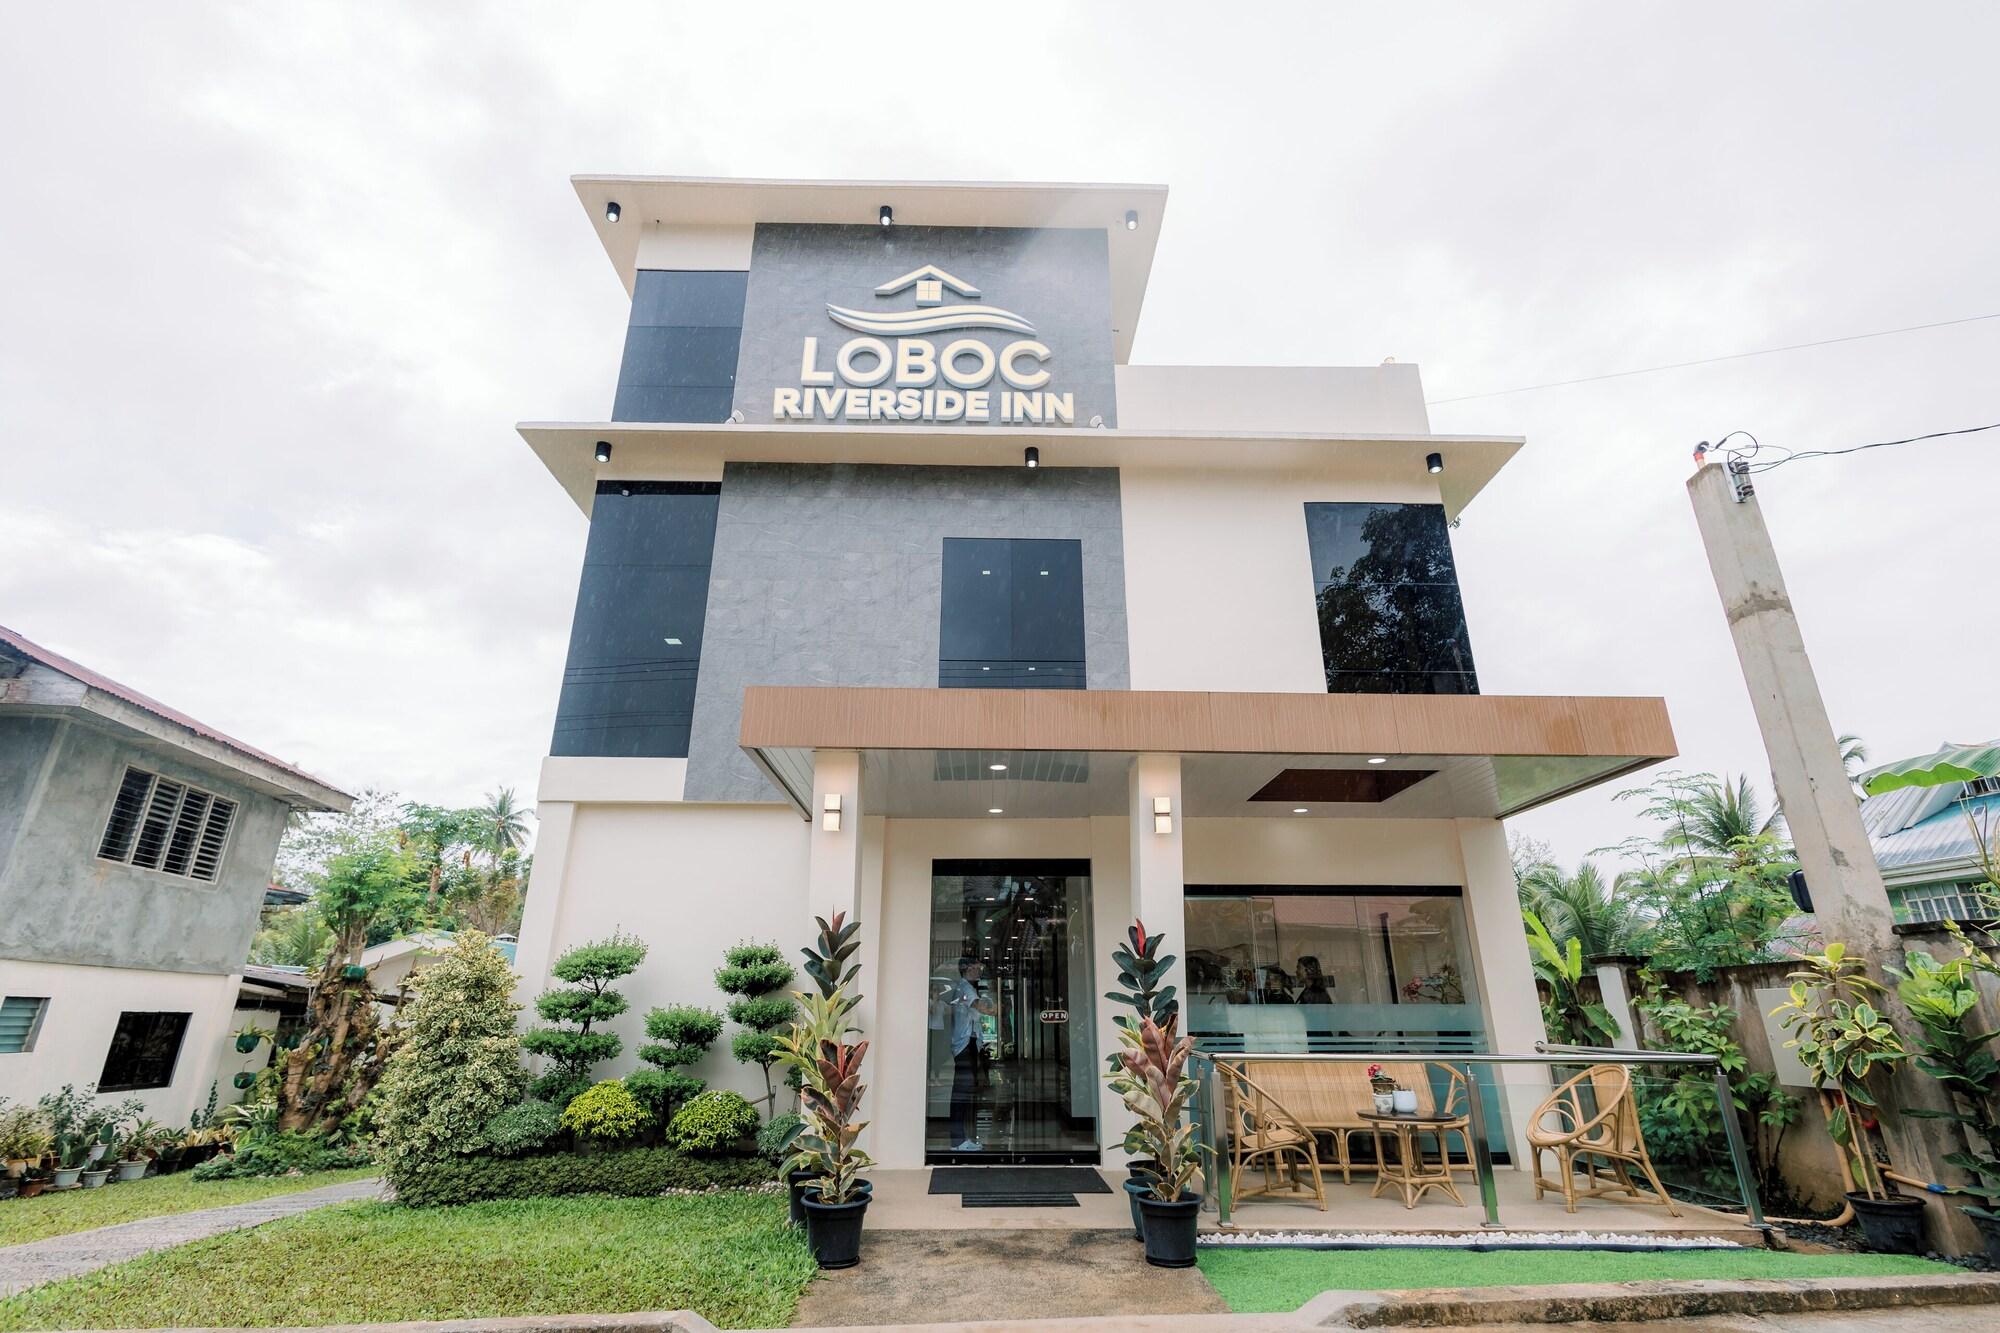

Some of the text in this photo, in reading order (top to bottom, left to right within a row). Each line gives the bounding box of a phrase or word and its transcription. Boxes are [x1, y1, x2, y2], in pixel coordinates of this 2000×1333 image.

[801, 337, 1051, 389] LOBOC
[773, 388, 1074, 423] RIVERSIDE INN
